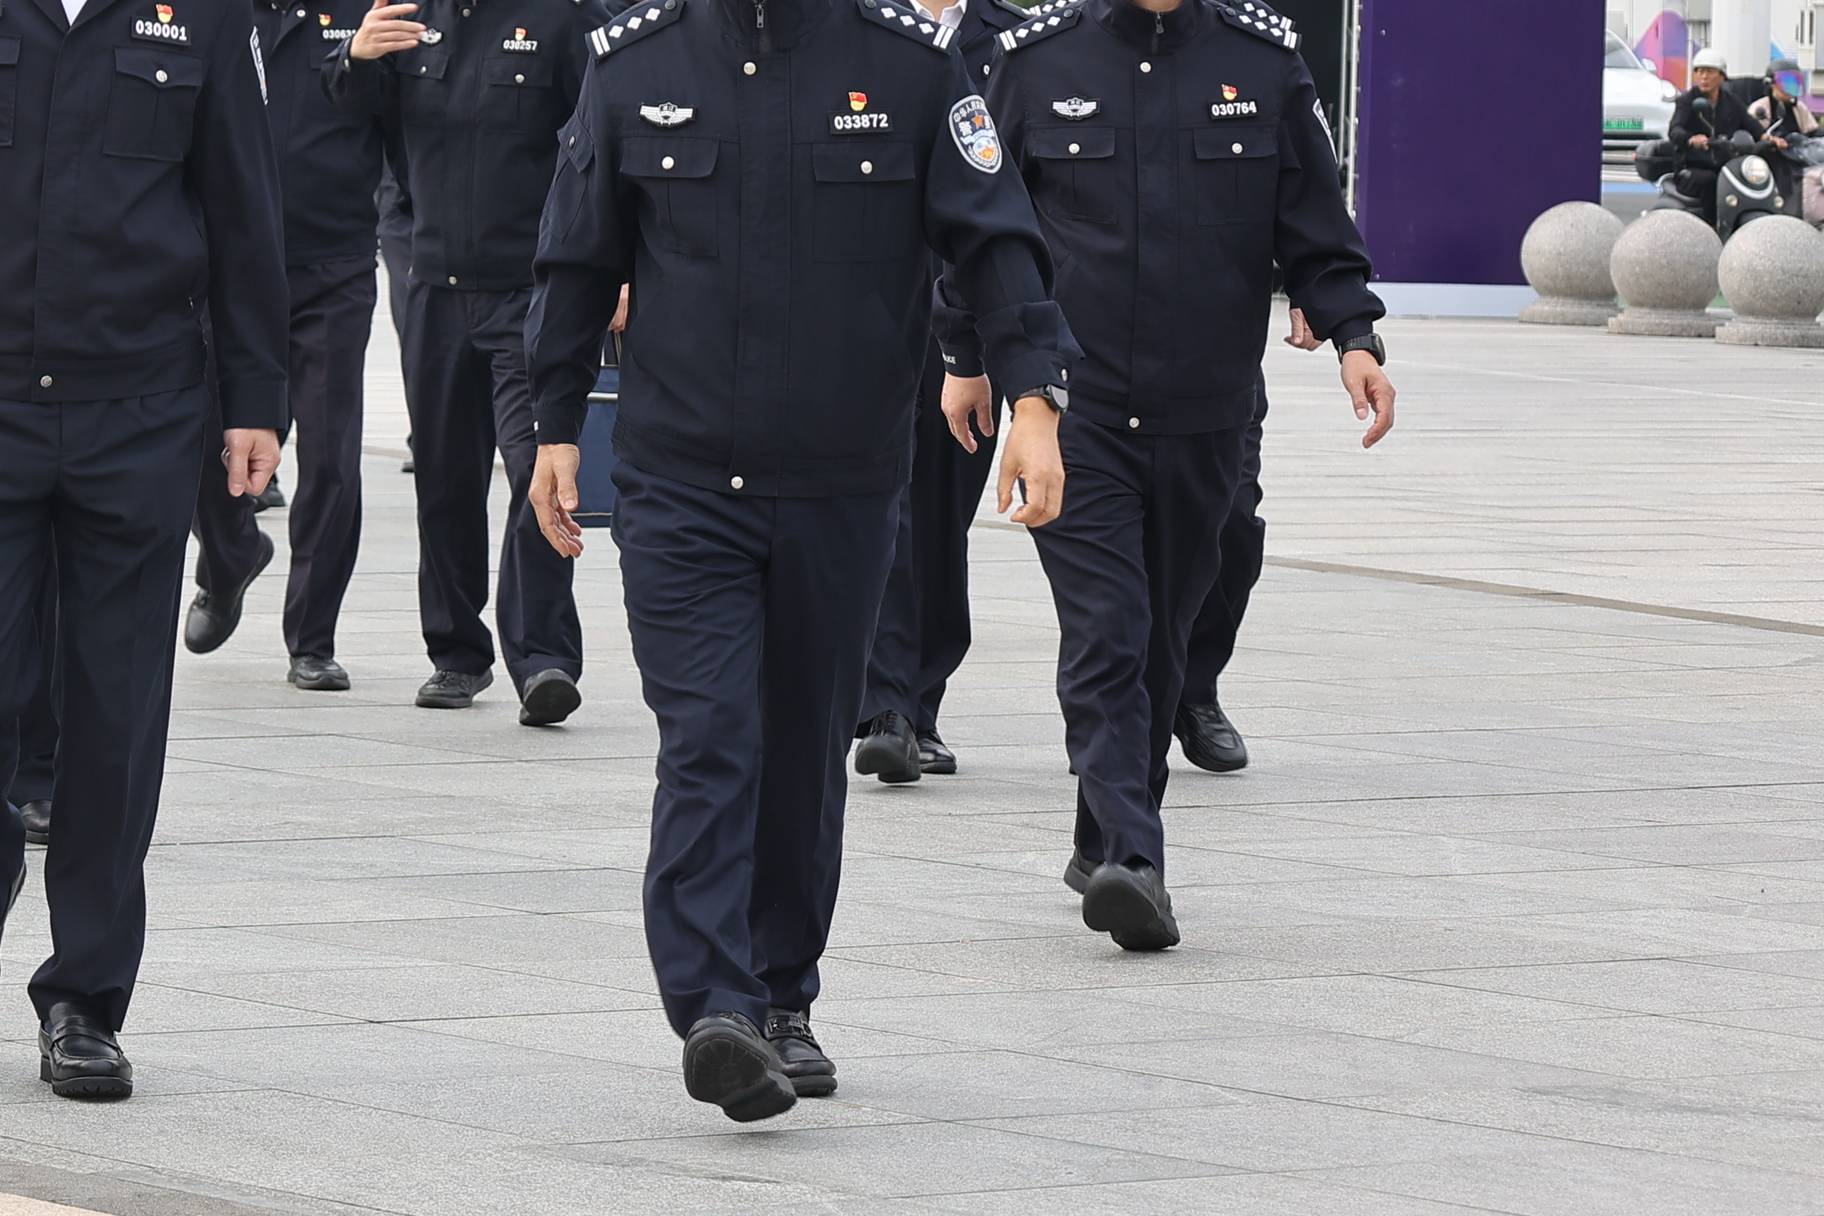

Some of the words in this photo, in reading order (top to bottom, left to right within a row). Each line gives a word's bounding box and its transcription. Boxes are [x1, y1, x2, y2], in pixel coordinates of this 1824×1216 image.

[135, 19, 187, 41] 030001
[1211, 101, 1257, 117] 030764
[834, 113, 889, 130] 033872
